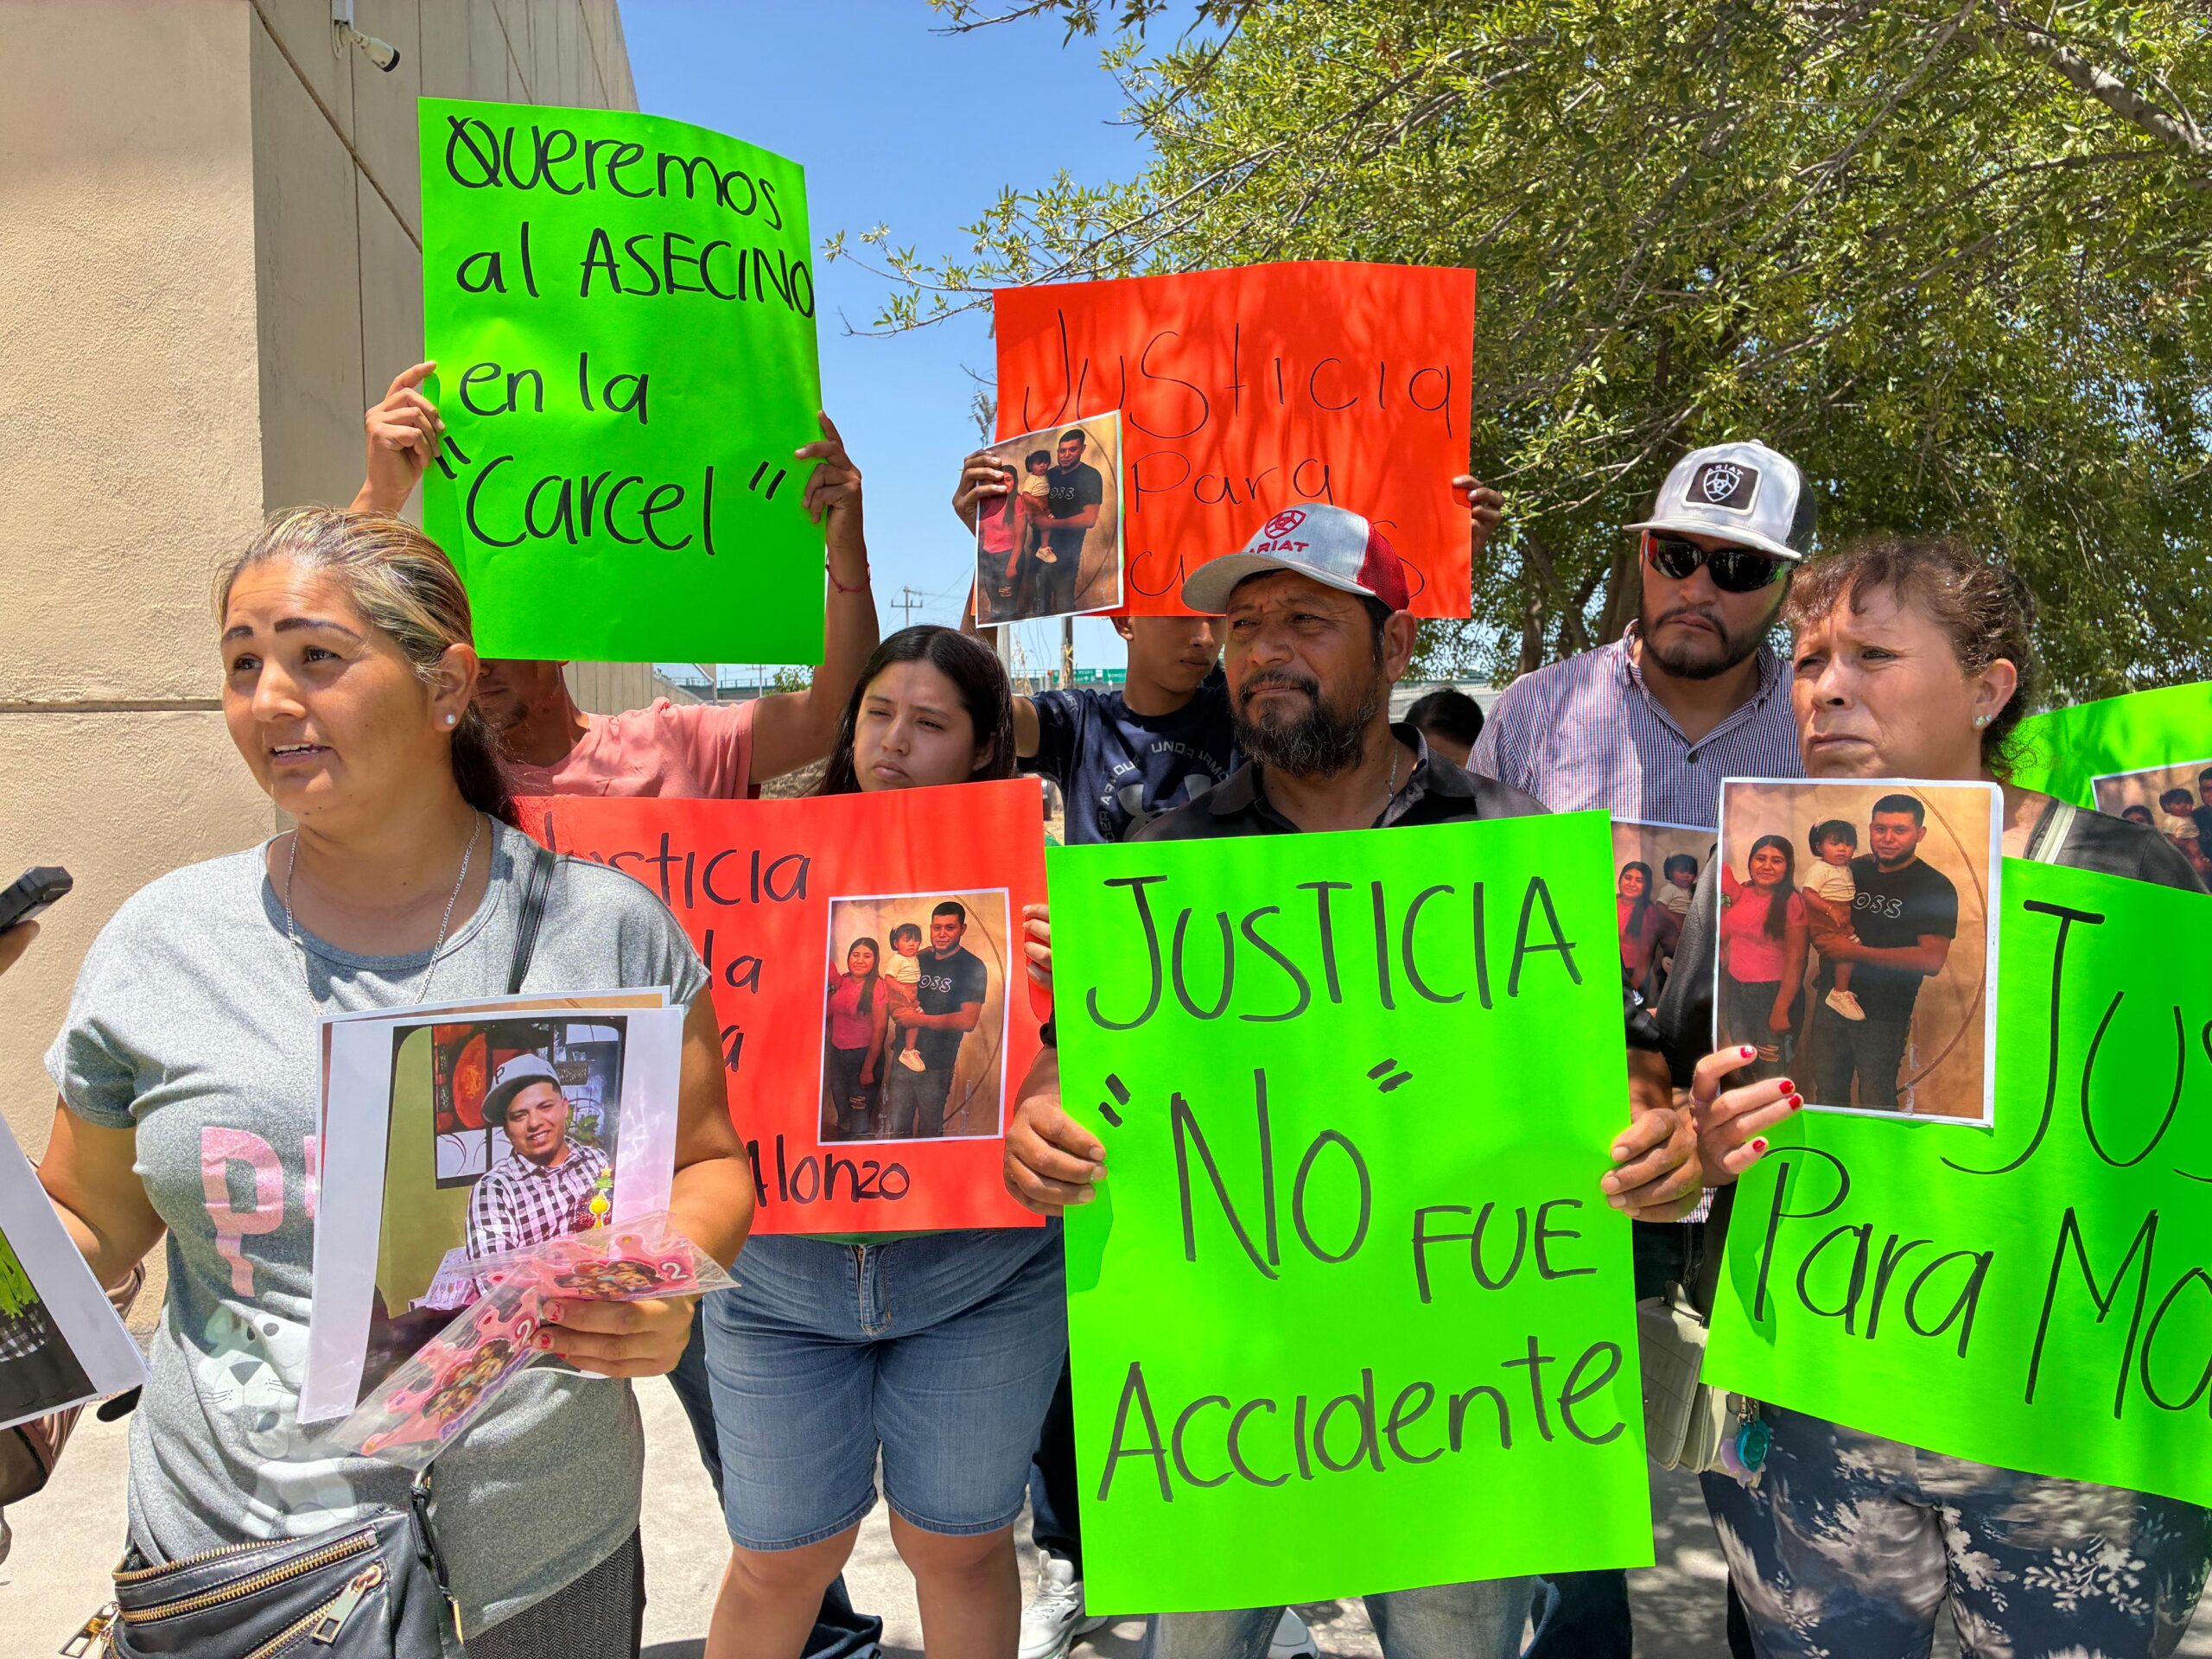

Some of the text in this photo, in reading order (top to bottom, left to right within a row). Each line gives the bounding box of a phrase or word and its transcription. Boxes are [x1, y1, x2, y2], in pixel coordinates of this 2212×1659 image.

[456, 221, 815, 318] al ASECINO
[460, 352, 649, 425] en la
[1131, 450, 1335, 513] Para
[1707, 463, 1744, 476] ARIAT
[1086, 874, 1583, 1031] JUSTICIA
[1412, 1198, 1599, 1304] FUE
[1752, 1146, 1993, 1359] Para
[1096, 1335, 1627, 1503] Accidente
